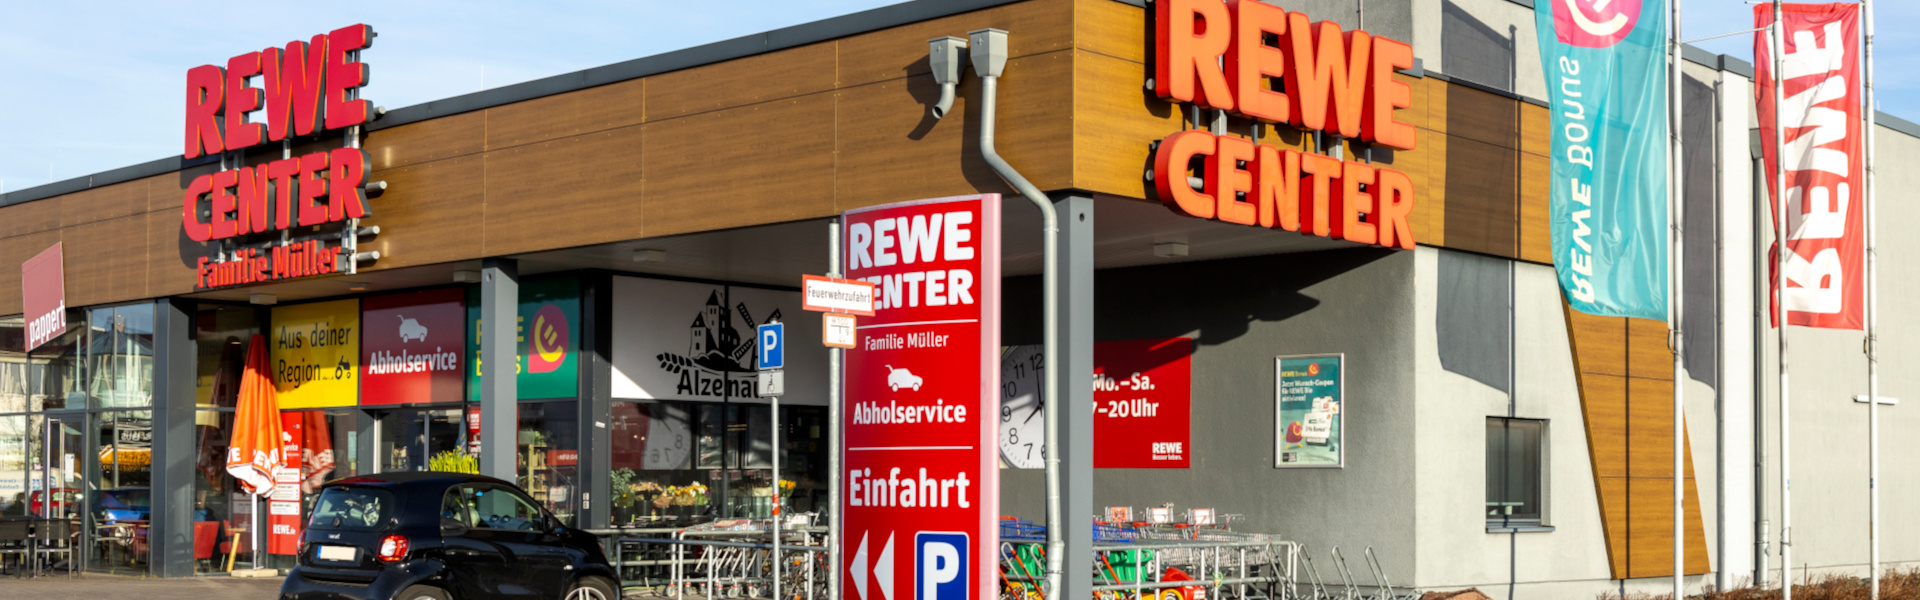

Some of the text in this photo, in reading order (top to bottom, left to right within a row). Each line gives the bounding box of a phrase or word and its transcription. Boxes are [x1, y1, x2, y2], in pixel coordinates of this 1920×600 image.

[1156, 0, 1416, 150] REWE
[184, 23, 372, 159] REWE
[183, 147, 371, 242] CENTER
[1155, 129, 1416, 250] CENTER
[850, 211, 974, 270] REWE
[197, 239, 342, 289] Familie Müller
[807, 286, 871, 303] Feuerwehrzufahrt
[278, 322, 351, 350] Aus deiner
[763, 329, 778, 364] P
[865, 331, 949, 351] Familie Müller
[278, 357, 321, 388] Region
[369, 347, 457, 375] Abholservice
[1014, 362, 1025, 380] 11
[1002, 381, 1017, 399] 10
[853, 399, 966, 425] Abholservice
[1002, 405, 1012, 423] 9
[1131, 398, 1160, 417] Uhr
[1009, 427, 1019, 445] 8
[1152, 442, 1182, 454] REWE
[1023, 442, 1033, 460] 7
[850, 467, 970, 508] Einfahrt
[923, 541, 960, 600] P
